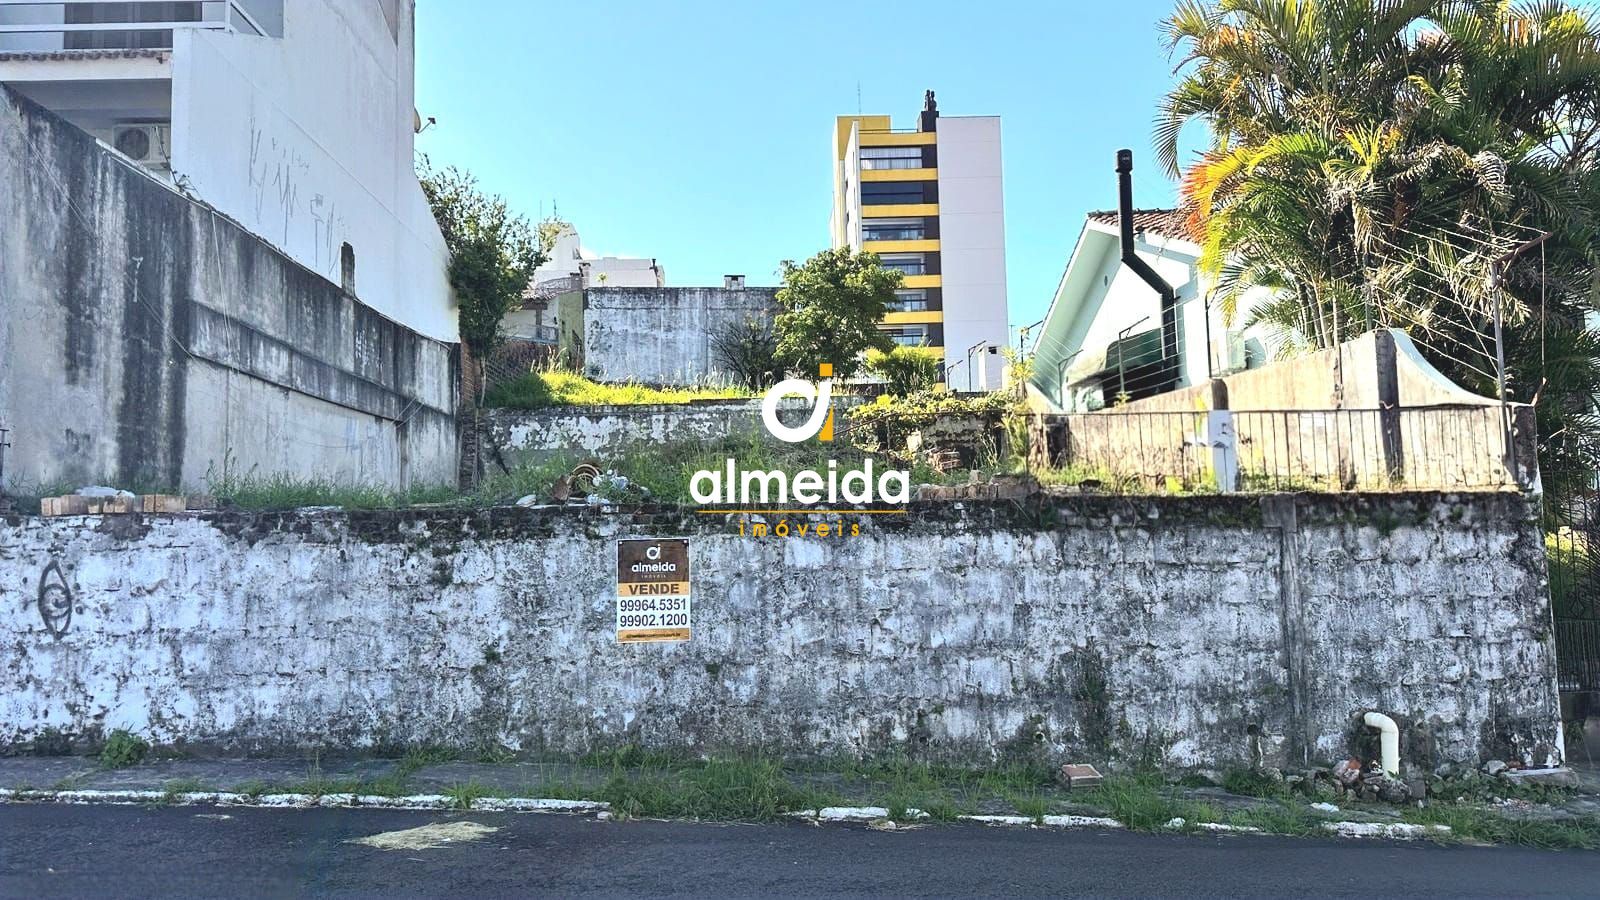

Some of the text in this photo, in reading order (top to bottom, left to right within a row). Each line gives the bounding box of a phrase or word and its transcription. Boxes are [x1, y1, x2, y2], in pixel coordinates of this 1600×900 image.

[631, 561, 676, 573] almeida
[628, 583, 680, 595] VENDE
[620, 598, 686, 612] 99964.5351
[620, 613, 688, 627] 99902.1200
